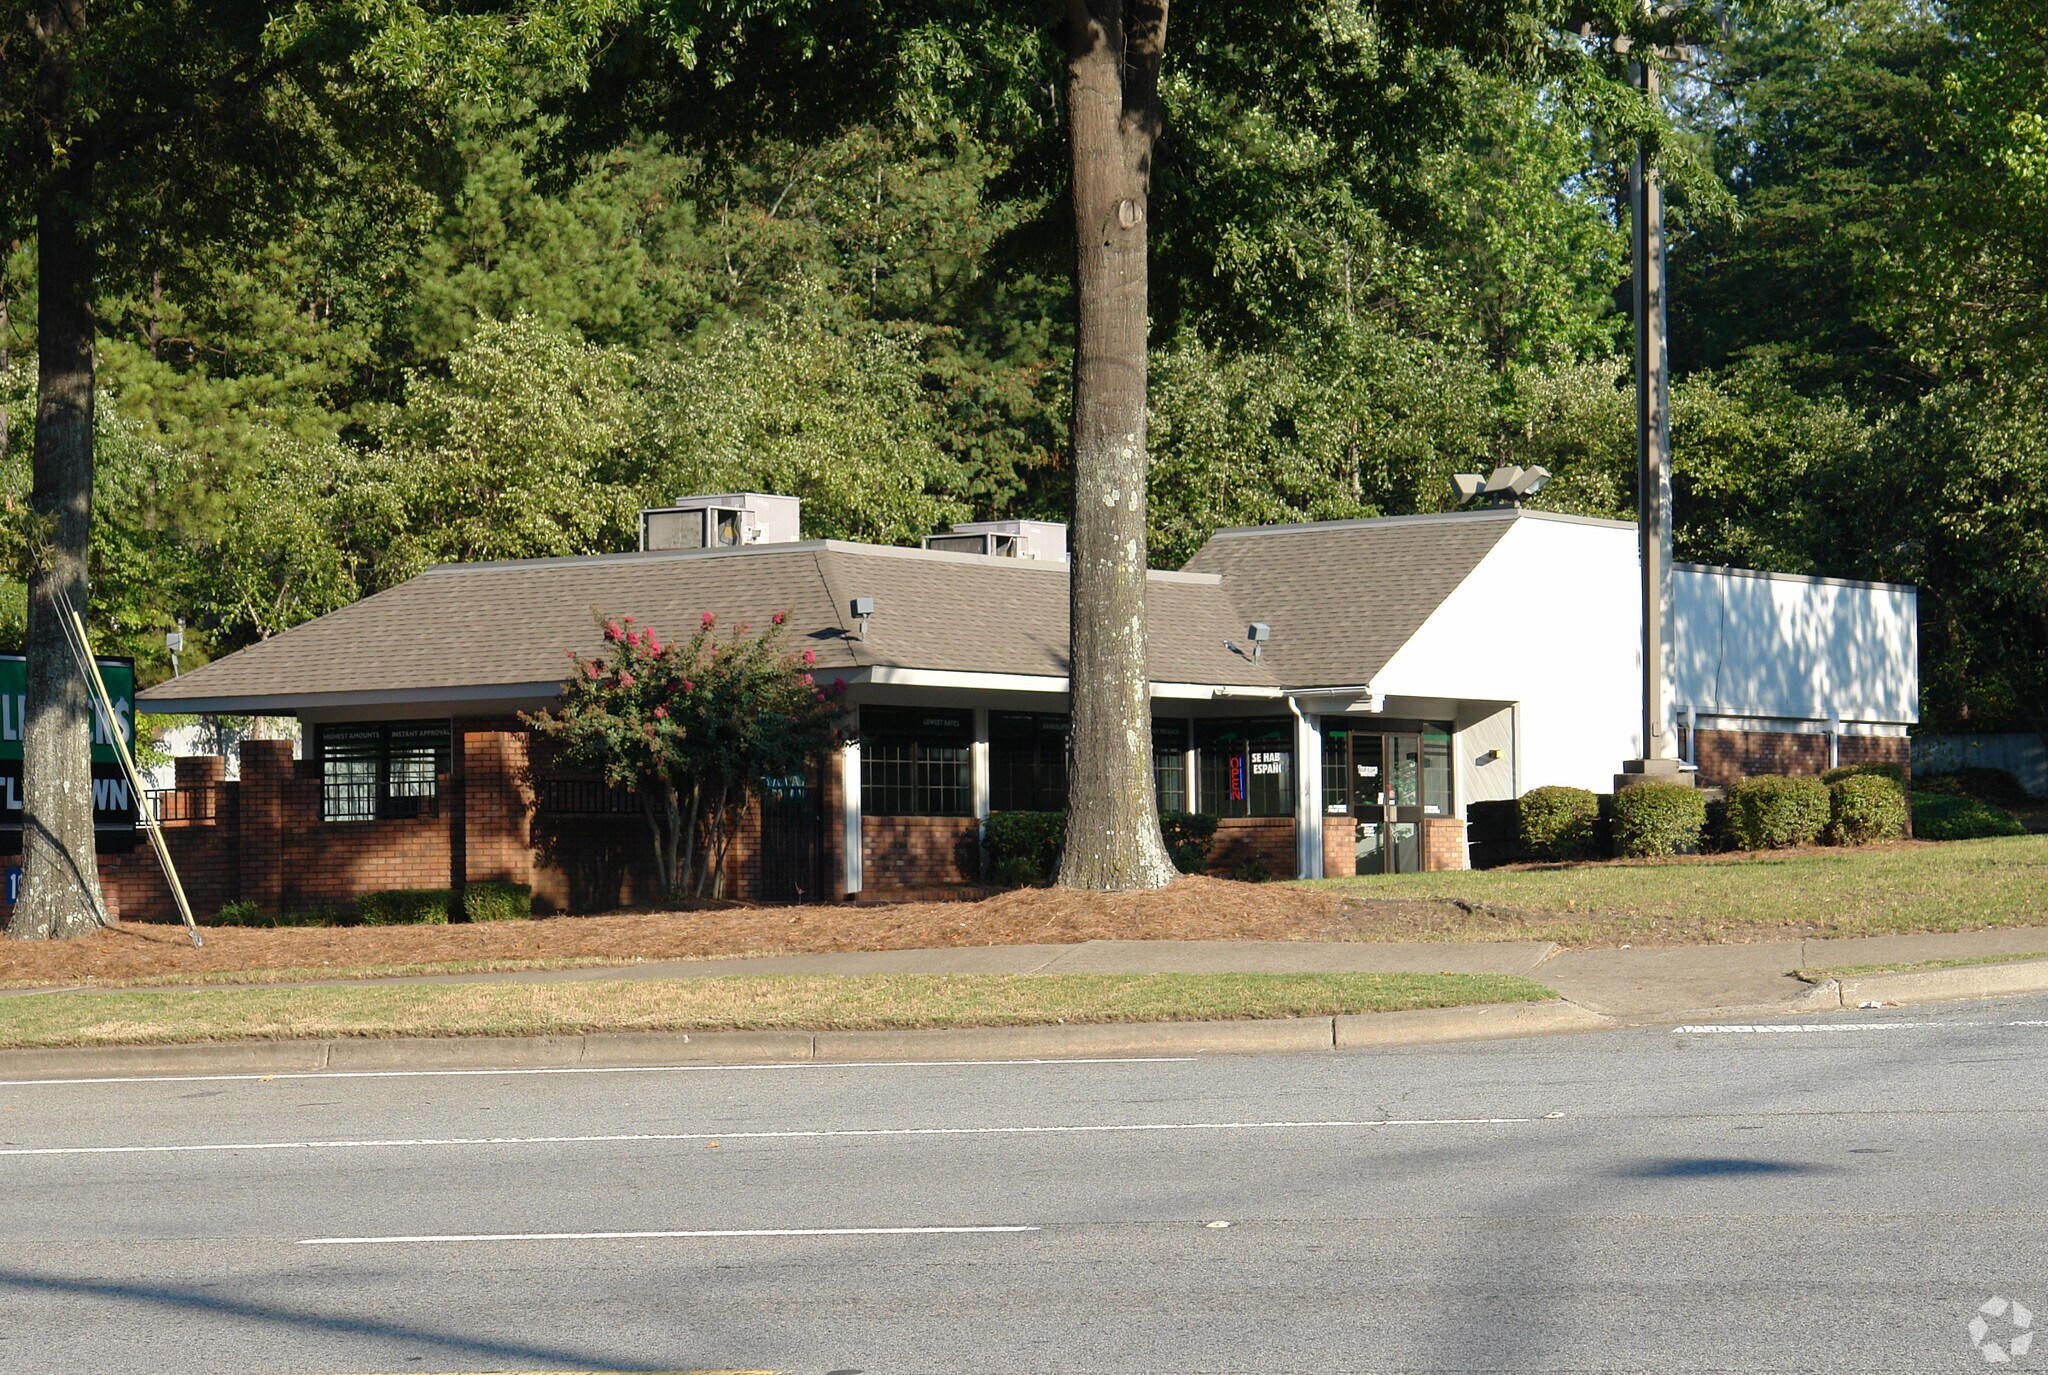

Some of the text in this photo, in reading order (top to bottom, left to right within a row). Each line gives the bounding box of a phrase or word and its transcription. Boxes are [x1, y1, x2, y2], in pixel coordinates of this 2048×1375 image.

[391, 730, 418, 738] INSTANT
[1251, 752, 1286, 763] SE HAB
[1253, 762, 1285, 775] ESPAÑ
[1230, 757, 1241, 800] OPEN
